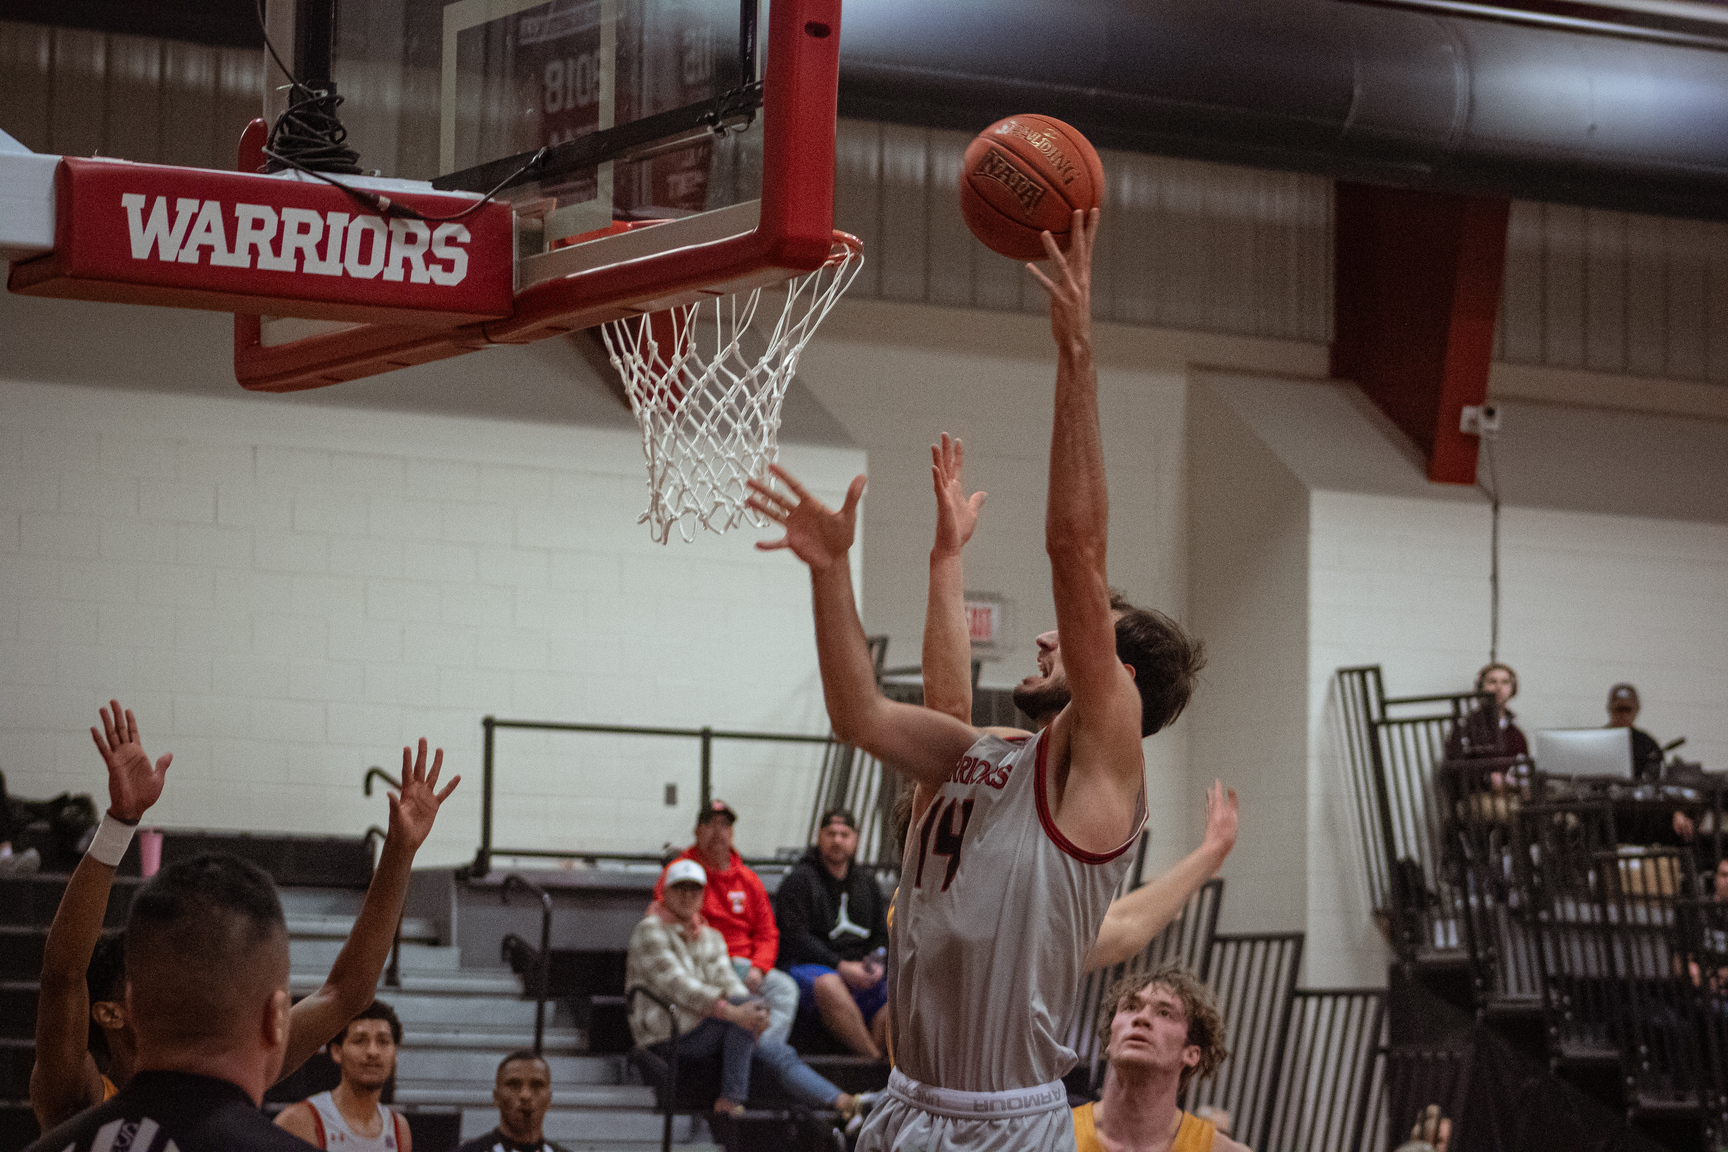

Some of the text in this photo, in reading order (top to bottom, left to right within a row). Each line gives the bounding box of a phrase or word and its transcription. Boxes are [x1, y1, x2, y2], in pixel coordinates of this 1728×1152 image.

[121, 193, 472, 287] WARRIORS
[915, 796, 975, 892] 14
[973, 1088, 1061, 1112] ARMOUR
